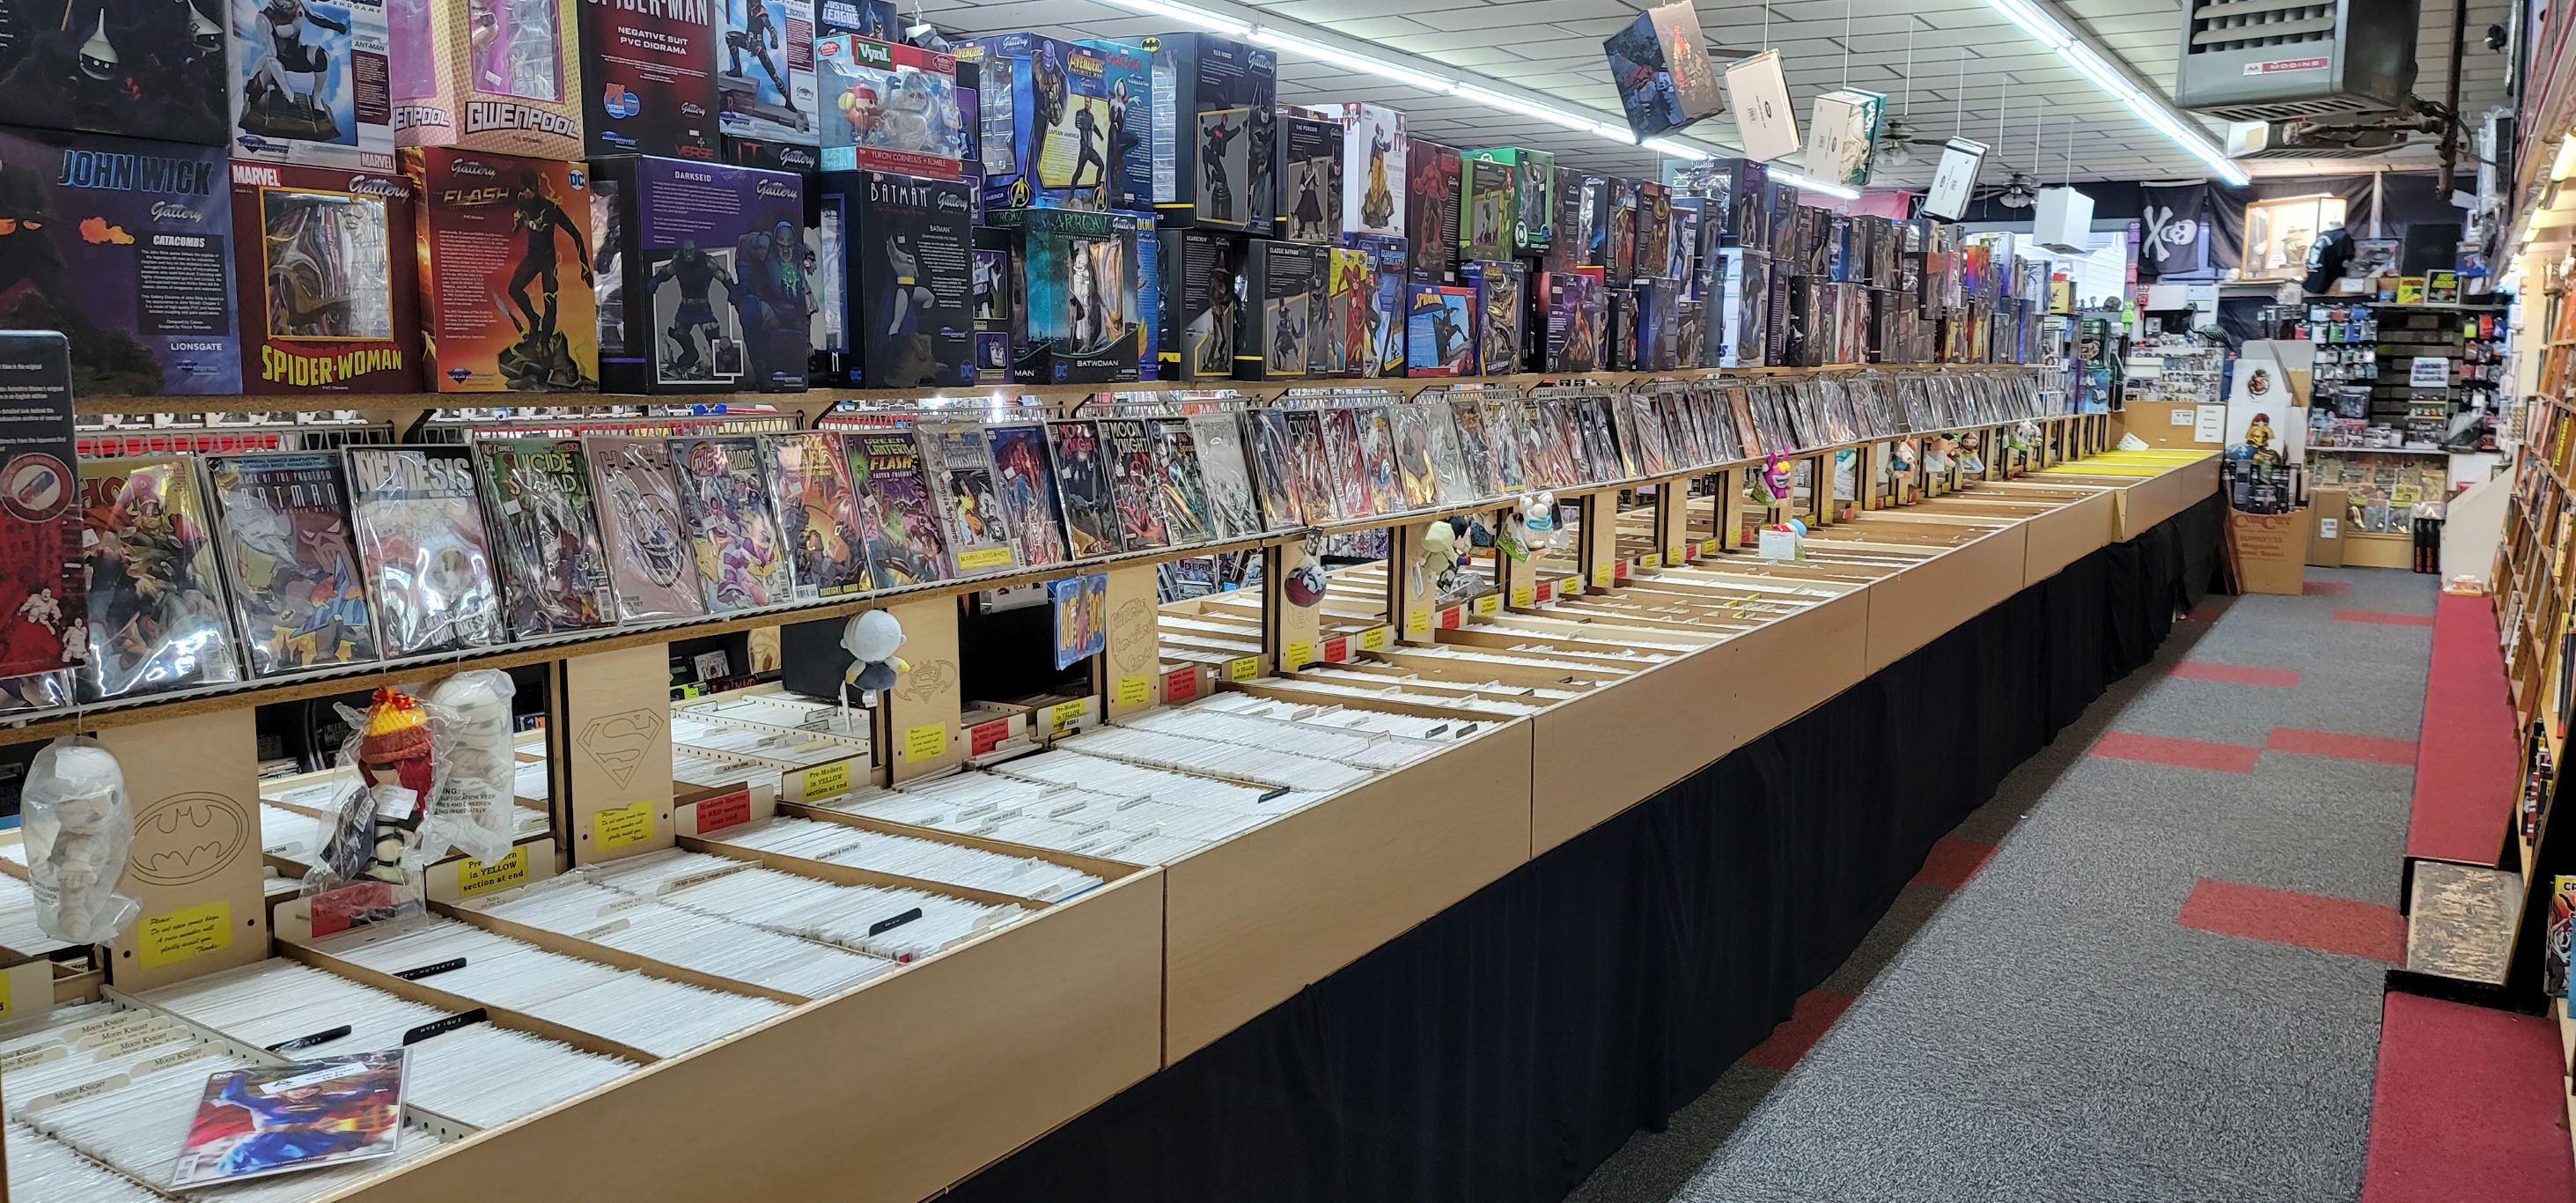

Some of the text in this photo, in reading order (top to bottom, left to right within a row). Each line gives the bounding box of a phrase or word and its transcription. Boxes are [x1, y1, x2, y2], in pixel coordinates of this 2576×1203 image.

[825, 0, 857, 12] JUSTICE
[823, 8, 860, 25] LEAGUE
[618, 26, 688, 46] NEGATIVE SUIT
[354, 41, 385, 51] ANT-MAN
[620, 36, 687, 55] PVC DIORAMA
[1248, 50, 1276, 72] Gallery
[2270, 61, 2320, 70] MODINE
[466, 101, 579, 141] GWENPOOL
[361, 152, 394, 170] MARVEL
[780, 147, 815, 169] Gallery
[871, 151, 893, 160] YUKON
[893, 153, 923, 164] CORNELIUS
[57, 149, 214, 197] JOHN WICK
[232, 165, 281, 188] MARVEL
[451, 158, 497, 179] Gallery
[674, 171, 711, 182] DARKSEID
[349, 174, 413, 203] Gallery
[569, 173, 585, 188] DC
[444, 187, 510, 204] FLASH
[756, 179, 798, 203] Gallery
[871, 182, 928, 208] BATMAN
[938, 190, 968, 210] Gallery
[151, 201, 203, 222] Gallery
[930, 225, 950, 233] BATMAN
[1056, 211, 1110, 234] ARROW
[1113, 217, 1136, 232] Gallery
[152, 234, 206, 248] CATACOMBS
[170, 343, 223, 351] LIONSGATE
[1108, 422, 1140, 438] MOON
[493, 444, 514, 454] COMICS
[867, 443, 912, 455] LANTERN
[1064, 437, 1095, 456] KNIGHT
[1115, 438, 1149, 457] KNIGHT
[503, 453, 575, 474] SUICIDE
[870, 454, 914, 471] FLASH
[353, 457, 475, 492] NEMESIS
[240, 483, 338, 511] BATMAN
[1184, 562, 1211, 572] DEAD
[809, 765, 843, 779] Pre-Modern
[818, 773, 843, 786] YELLOW
[806, 786, 828, 797] section
[836, 780, 848, 790] end
[480, 860, 518, 876] YELLOW
[463, 879, 495, 891] section
[508, 870, 524, 880] end
[104, 1016, 129, 1027] KNIGHT
[124, 1022, 149, 1034] KNIGHT
[420, 1016, 462, 1034] MYSTIQUE
[143, 1033, 167, 1044] KNIGHT
[17, 1053, 43, 1064] KNIGHT
[177, 1048, 202, 1059] KNIGHT
[78, 1081, 106, 1093] KNIGHT
